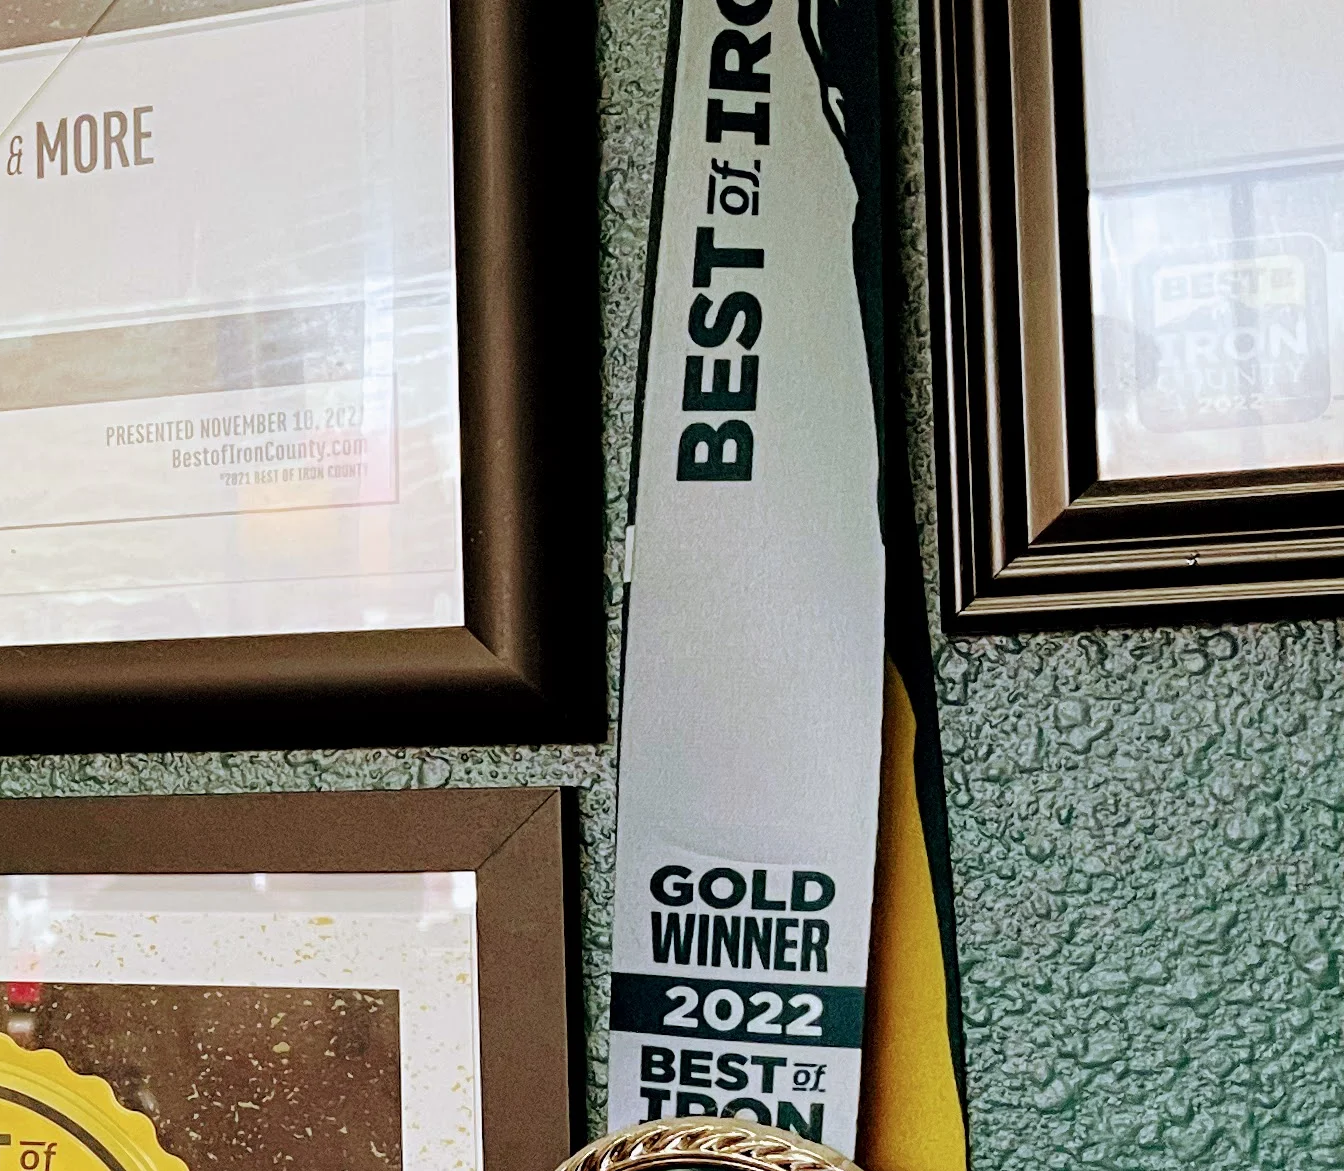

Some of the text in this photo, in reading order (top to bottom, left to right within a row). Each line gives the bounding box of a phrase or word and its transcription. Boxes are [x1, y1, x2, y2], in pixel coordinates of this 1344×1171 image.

[6, 135, 23, 175] &
[36, 106, 154, 180] MORE
[172, 437, 368, 468] BestofIronCounty.com
[650, 865, 836, 912] GOLD
[651, 911, 830, 973] WINNER
[663, 985, 824, 1037] 2022
[641, 1045, 827, 1094] BEST of
